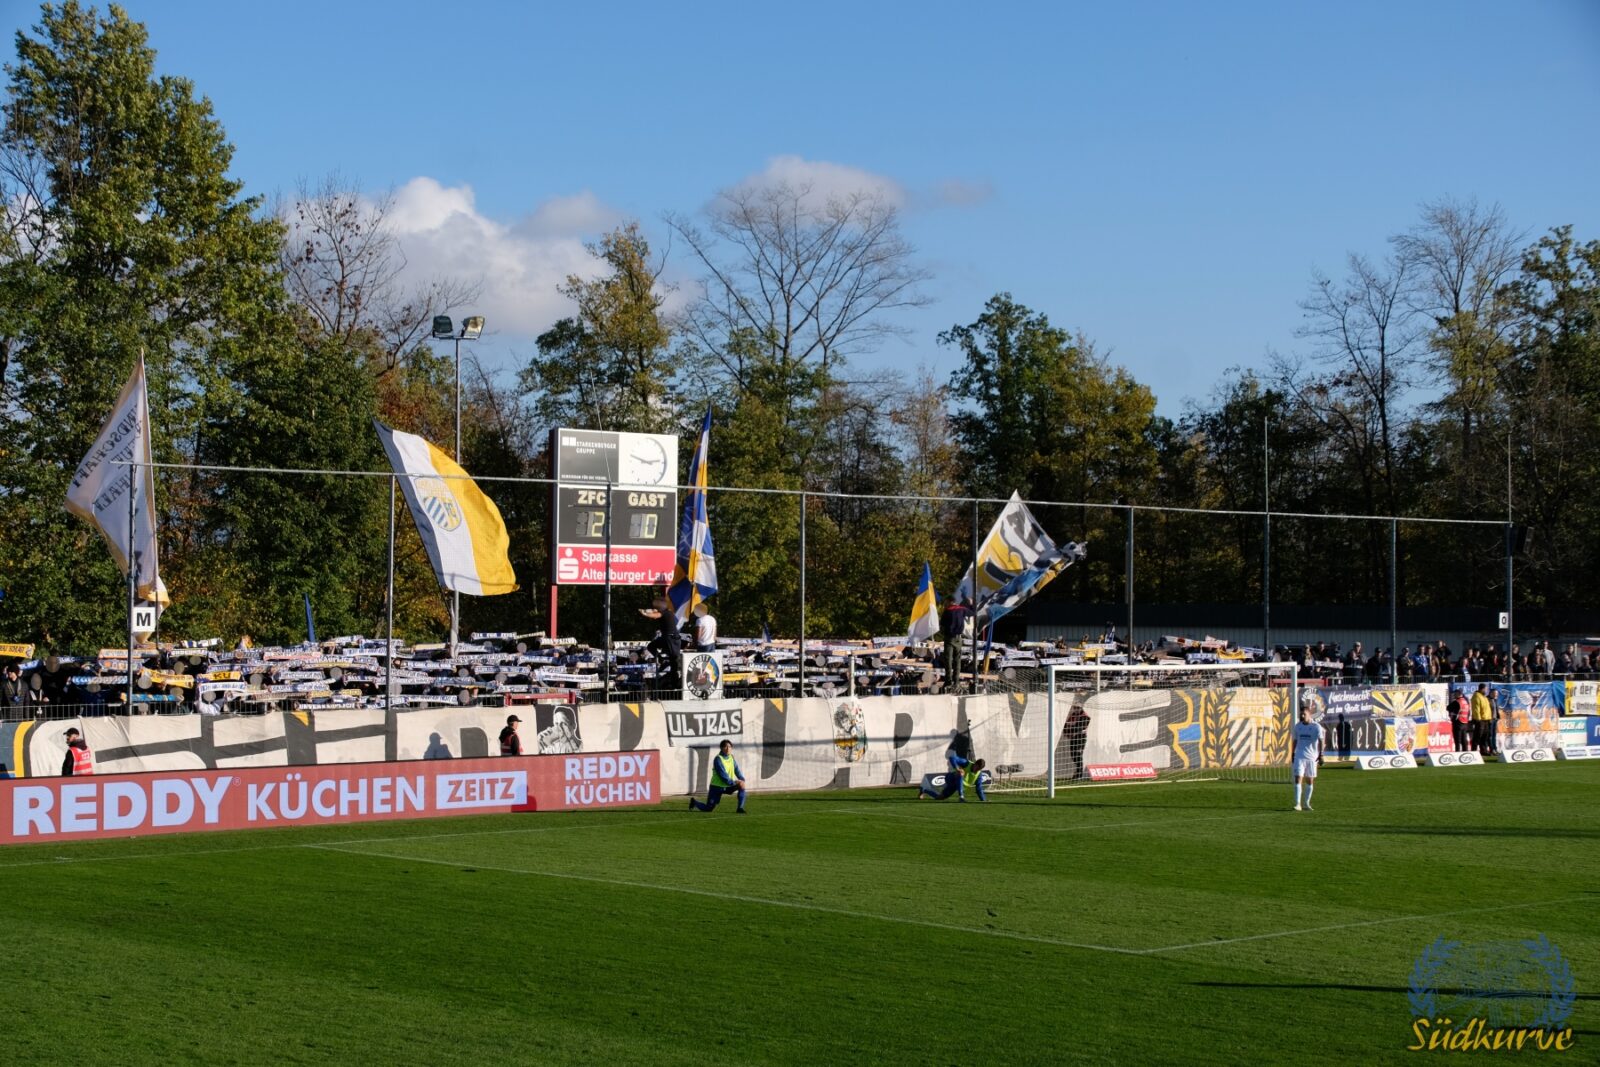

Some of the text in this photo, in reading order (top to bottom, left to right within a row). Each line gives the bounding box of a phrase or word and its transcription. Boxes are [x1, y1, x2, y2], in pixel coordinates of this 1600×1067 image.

[576, 447, 596, 455] GRUPPE
[578, 490, 667, 508] ZFC GAST
[591, 511, 605, 537] 2
[581, 549, 638, 565] Sparasse
[648, 569, 674, 582] Land
[136, 612, 151, 627] M
[667, 710, 742, 736] ULTRAS
[565, 754, 651, 781] REDDY
[1089, 765, 1154, 777] REDDY KÜCHEN
[247, 772, 425, 822] KÜCHEN
[447, 777, 515, 803] ZEITZ
[565, 780, 651, 806] KÜCHEN
